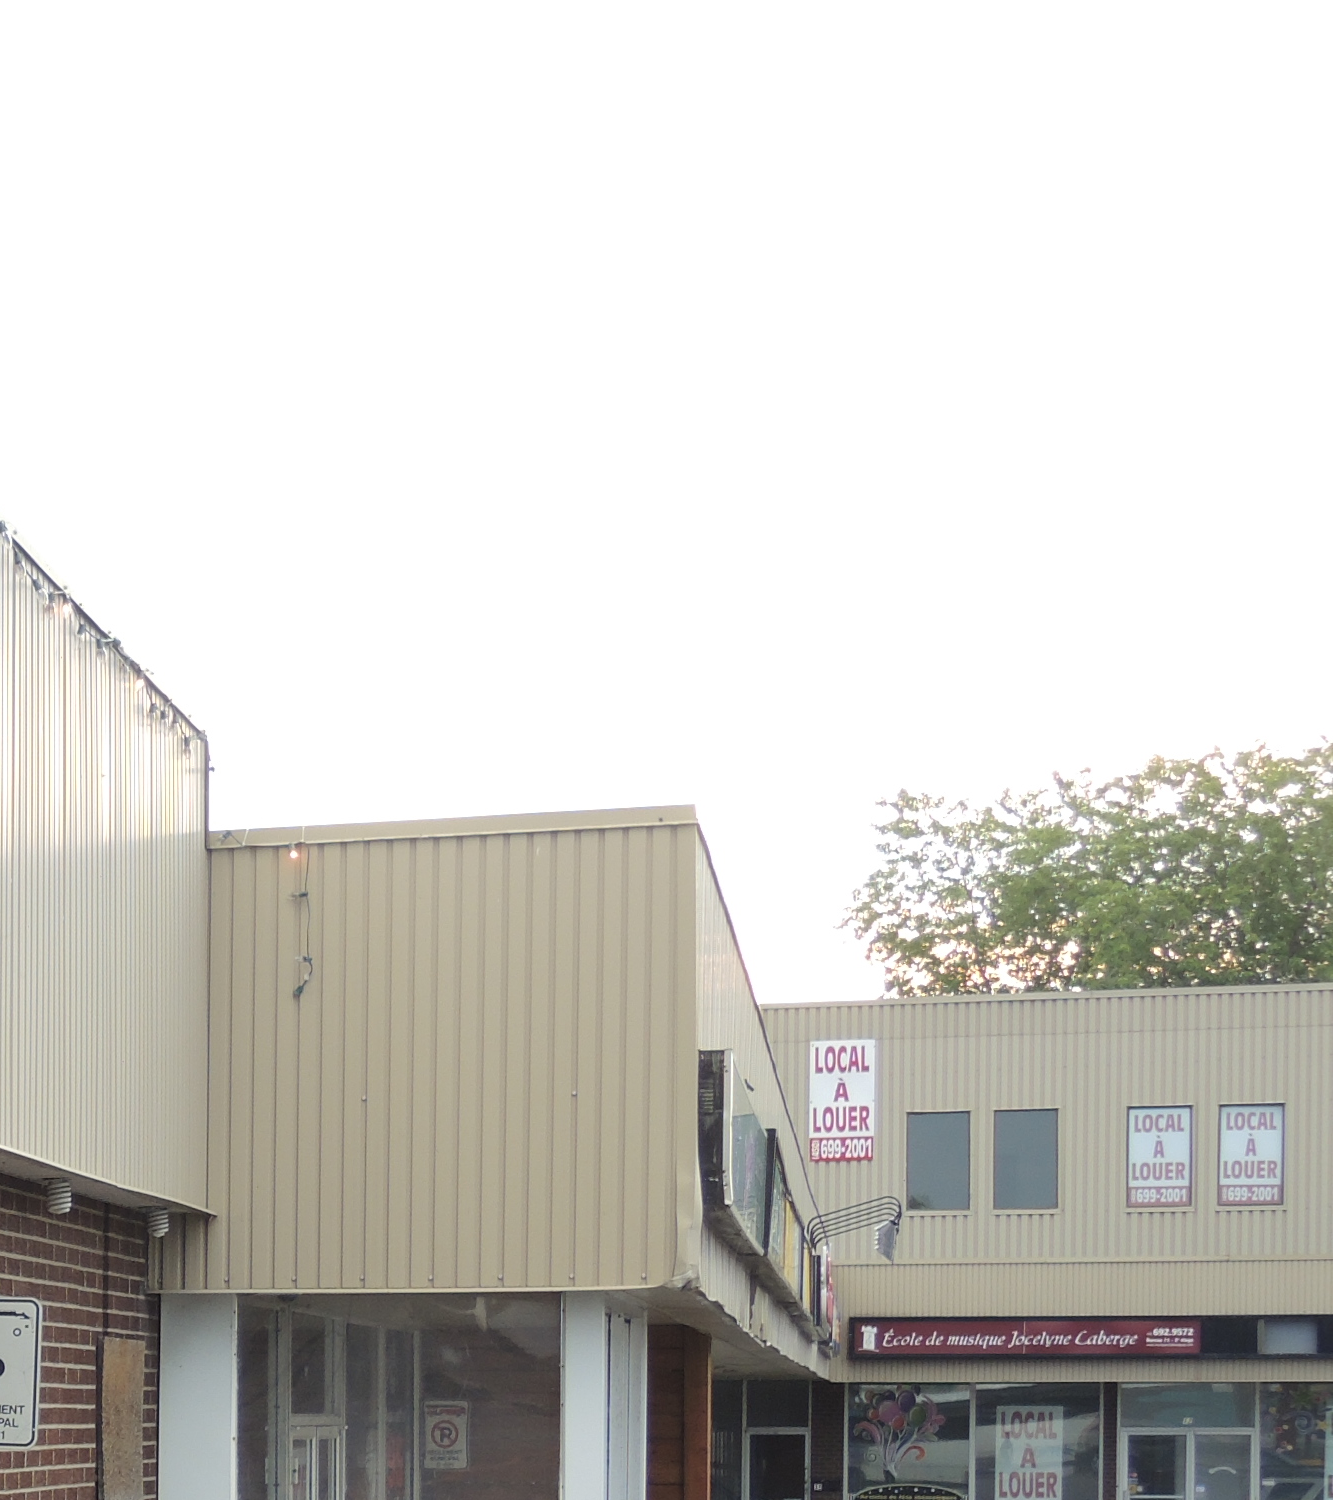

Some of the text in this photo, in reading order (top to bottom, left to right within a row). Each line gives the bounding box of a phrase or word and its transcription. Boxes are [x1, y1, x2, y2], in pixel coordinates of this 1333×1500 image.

[814, 1045, 870, 1074] LOCAL
[833, 1077, 849, 1102] À
[813, 1105, 870, 1133] LOUER
[1134, 1113, 1185, 1133] LOCAL
[1225, 1111, 1277, 1131] LOCAL
[820, 1138, 873, 1159] 699-2001
[1152, 1134, 1165, 1159] À
[1244, 1132, 1257, 1157] À
[1131, 1161, 1186, 1181] LOUER
[1222, 1160, 1278, 1179] LOUER
[1136, 1187, 1187, 1203] 699-2001
[1227, 1186, 1278, 1201] 699-2001
[882, 1328, 922, 1348] École
[925, 1331, 944, 1346] de
[947, 1333, 1006, 1350] musique
[1007, 1330, 1071, 1349] Jocelyne
[1074, 1330, 1139, 1348] Laberge
[1000, 1411, 1058, 1440] LOCAL
[1020, 1443, 1037, 1469] À
[998, 1471, 1058, 1499] LOUER
